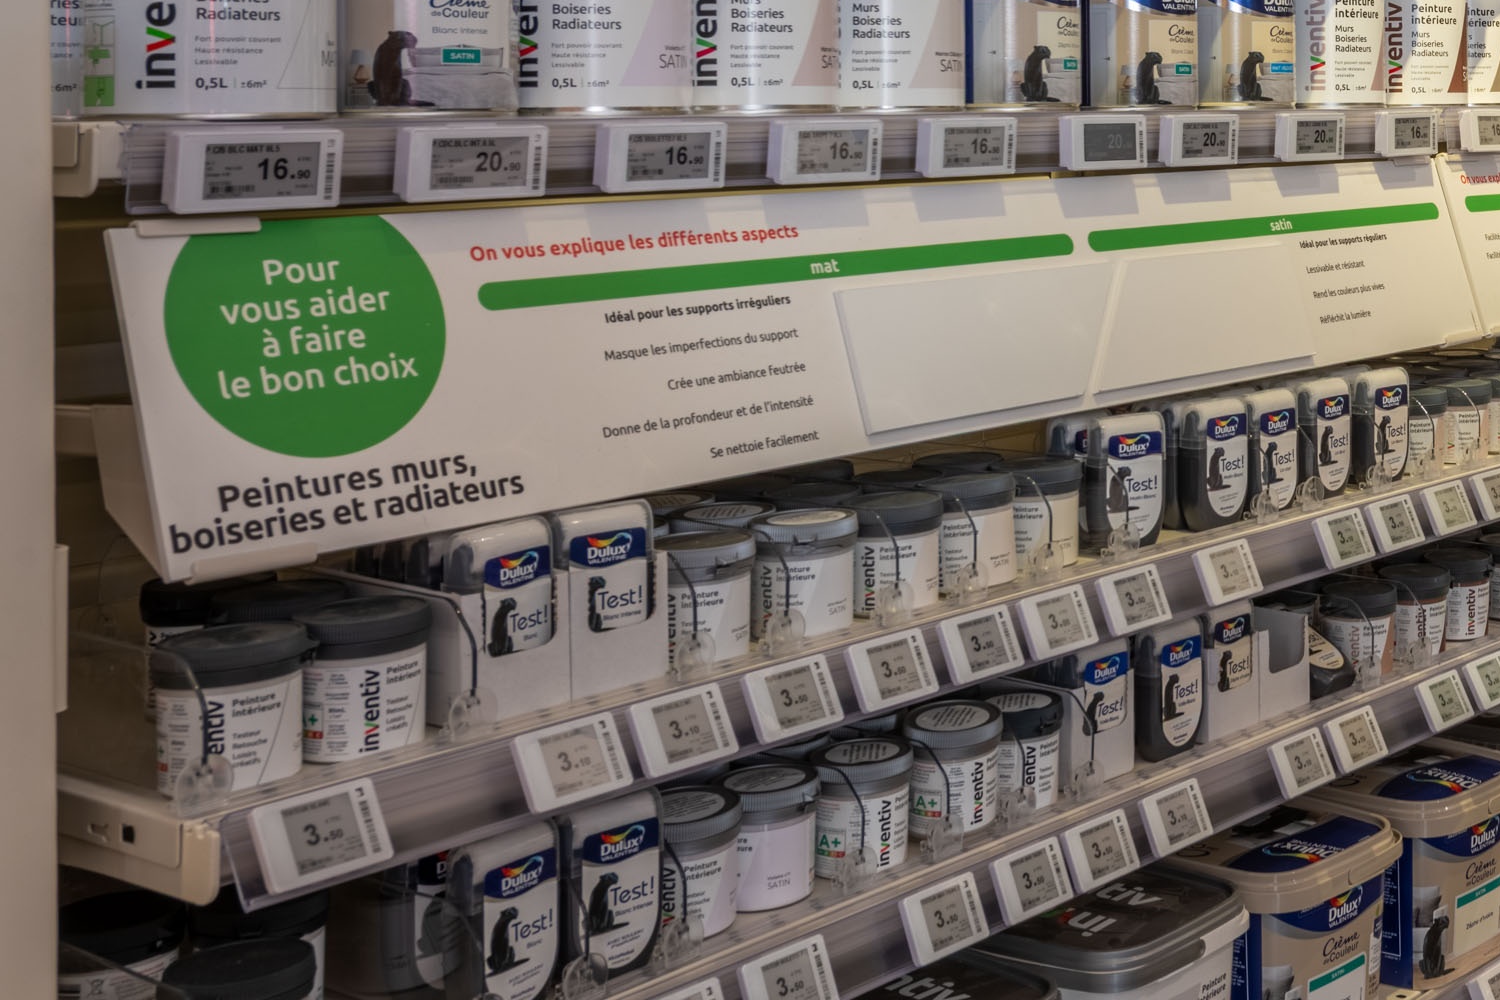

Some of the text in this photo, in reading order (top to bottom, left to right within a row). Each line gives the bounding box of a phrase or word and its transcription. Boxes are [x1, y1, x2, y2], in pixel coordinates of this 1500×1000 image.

[196, 7, 281, 22] Radiateurs
[449, 51, 476, 60] SATIN
[195, 77, 228, 90] 0,5L
[257, 157, 311, 181] 16.90
[1460, 174, 1470, 185] On
[1470, 173, 1487, 184] vous
[1269, 217, 1293, 232] satin
[469, 224, 800, 262] On vous explique les différents aspects
[1299, 238, 1315, 249] Idéal
[1328, 236, 1338, 246] les
[262, 258, 340, 286] Pour
[810, 258, 840, 276] mat
[219, 287, 390, 325] vous aider
[604, 293, 792, 324] Idéal pour les supports irréguliers
[262, 324, 367, 358] à faire
[604, 328, 799, 362] Masque les imperfections du support
[218, 353, 419, 400] le bon choix
[667, 361, 807, 391] Crée une ambiance feutrée
[602, 395, 814, 440] Donne de la profondeur et de l'intensité
[710, 429, 820, 459] Se nettoie facilement
[217, 454, 477, 512] Peintures murs,
[1125, 474, 1158, 493] Test!
[169, 475, 525, 555] boiseries et radiateurs
[586, 537, 631, 561] Dulux
[499, 561, 539, 582] Dulux
[598, 585, 643, 612] Test!
[509, 604, 549, 634] Test!
[359, 668, 381, 753] inventiv
[600, 834, 641, 858] Dulux
[1470, 826, 1500, 850] Dulux
[1470, 838, 1497, 854] VALENTINE
[608, 875, 655, 908] Test!
